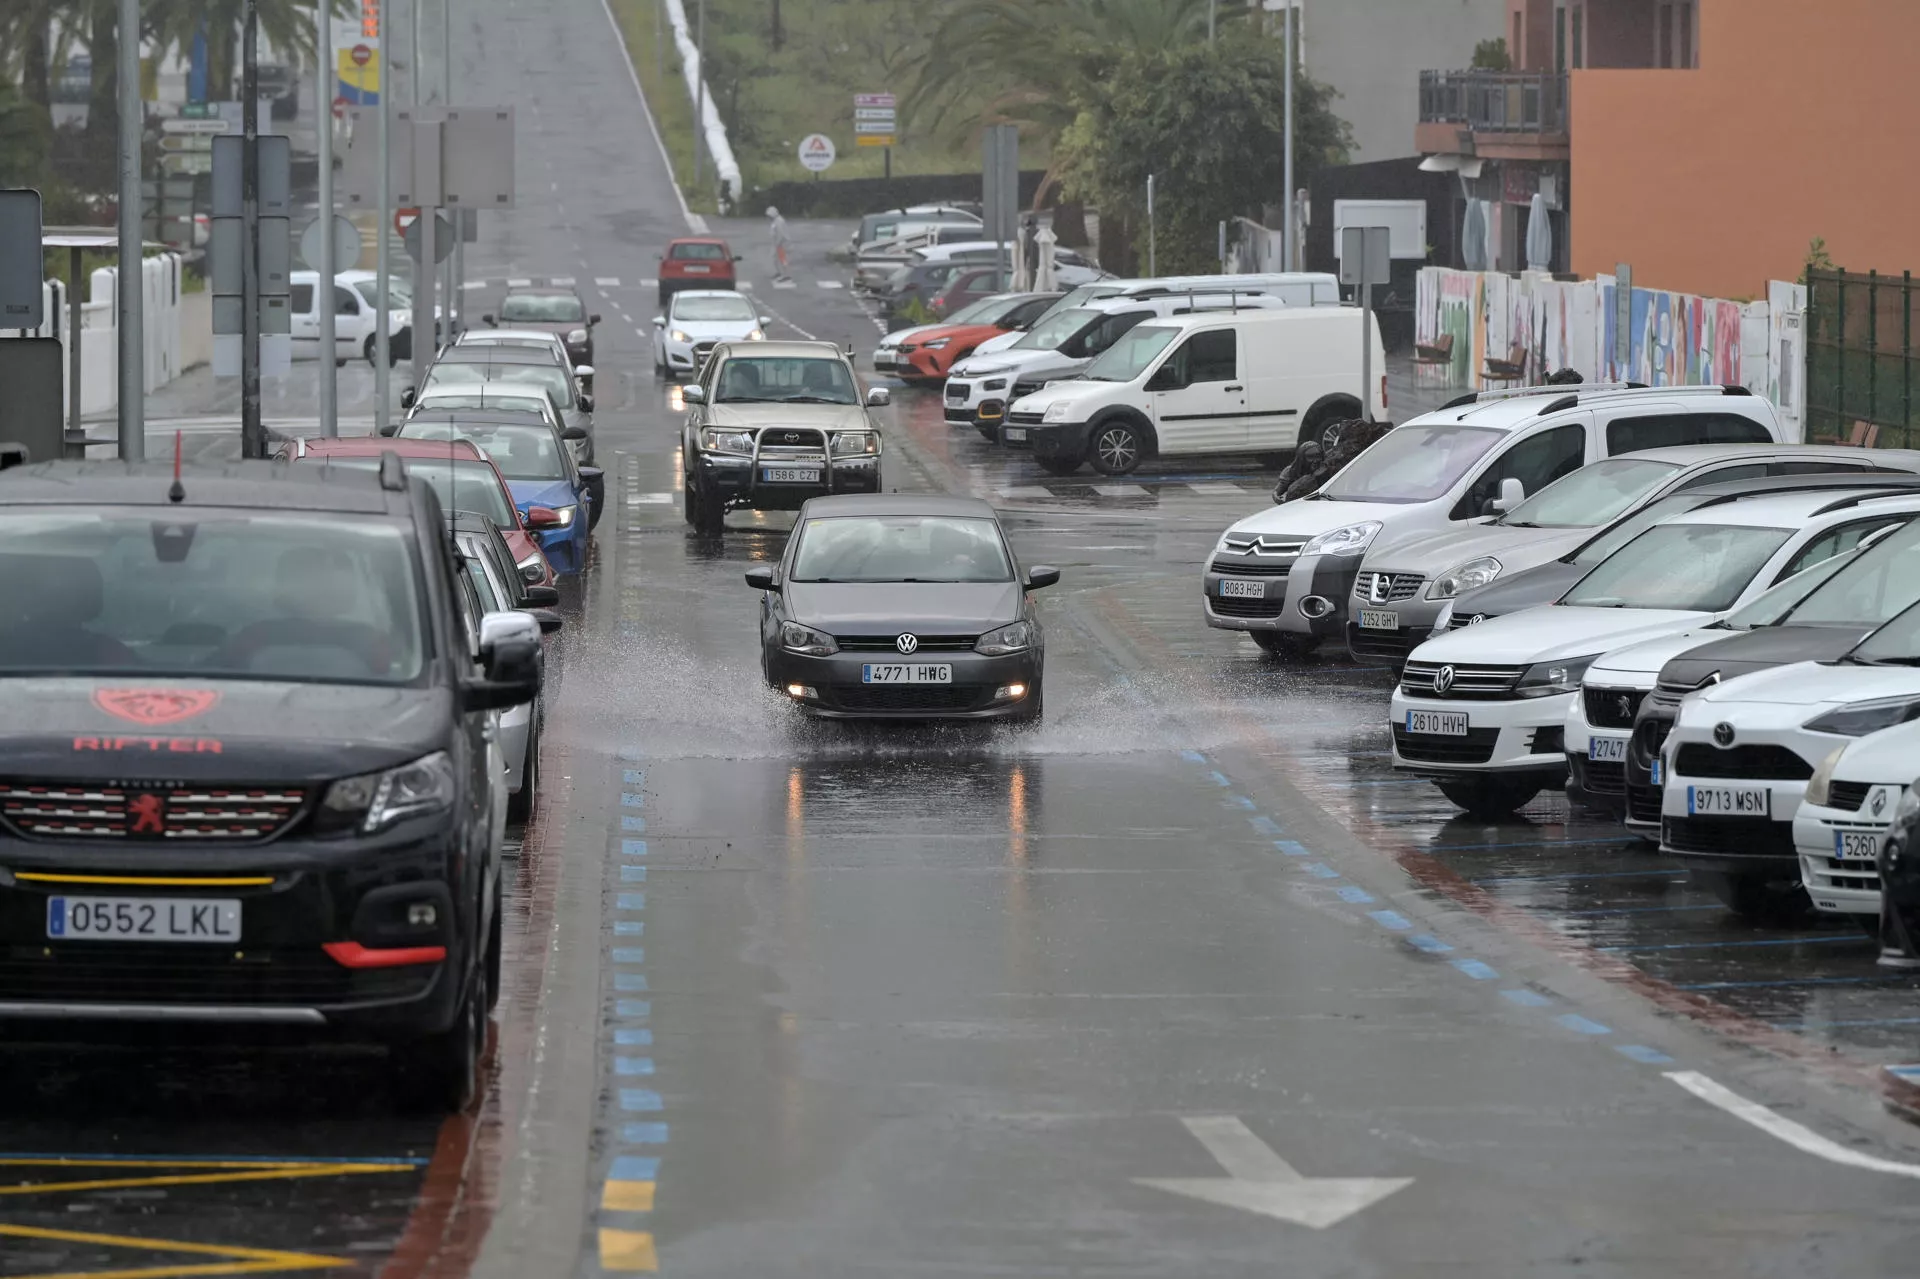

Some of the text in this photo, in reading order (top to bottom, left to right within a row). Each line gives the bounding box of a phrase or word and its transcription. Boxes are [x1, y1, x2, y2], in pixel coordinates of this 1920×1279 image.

[770, 470, 818, 481] 1586 CZT
[1224, 582, 1263, 597] 8083 HGH
[1362, 612, 1397, 627] 2252 GHY
[873, 666, 947, 681] 4771 HWG
[1413, 713, 1465, 734] 2610 HVH
[73, 737, 223, 753] RIFTER
[1596, 741, 1624, 759] 2747
[1696, 790, 1763, 812] 9713 MSN
[1845, 835, 1877, 857] 5260
[72, 902, 231, 935] 0552 LKL
